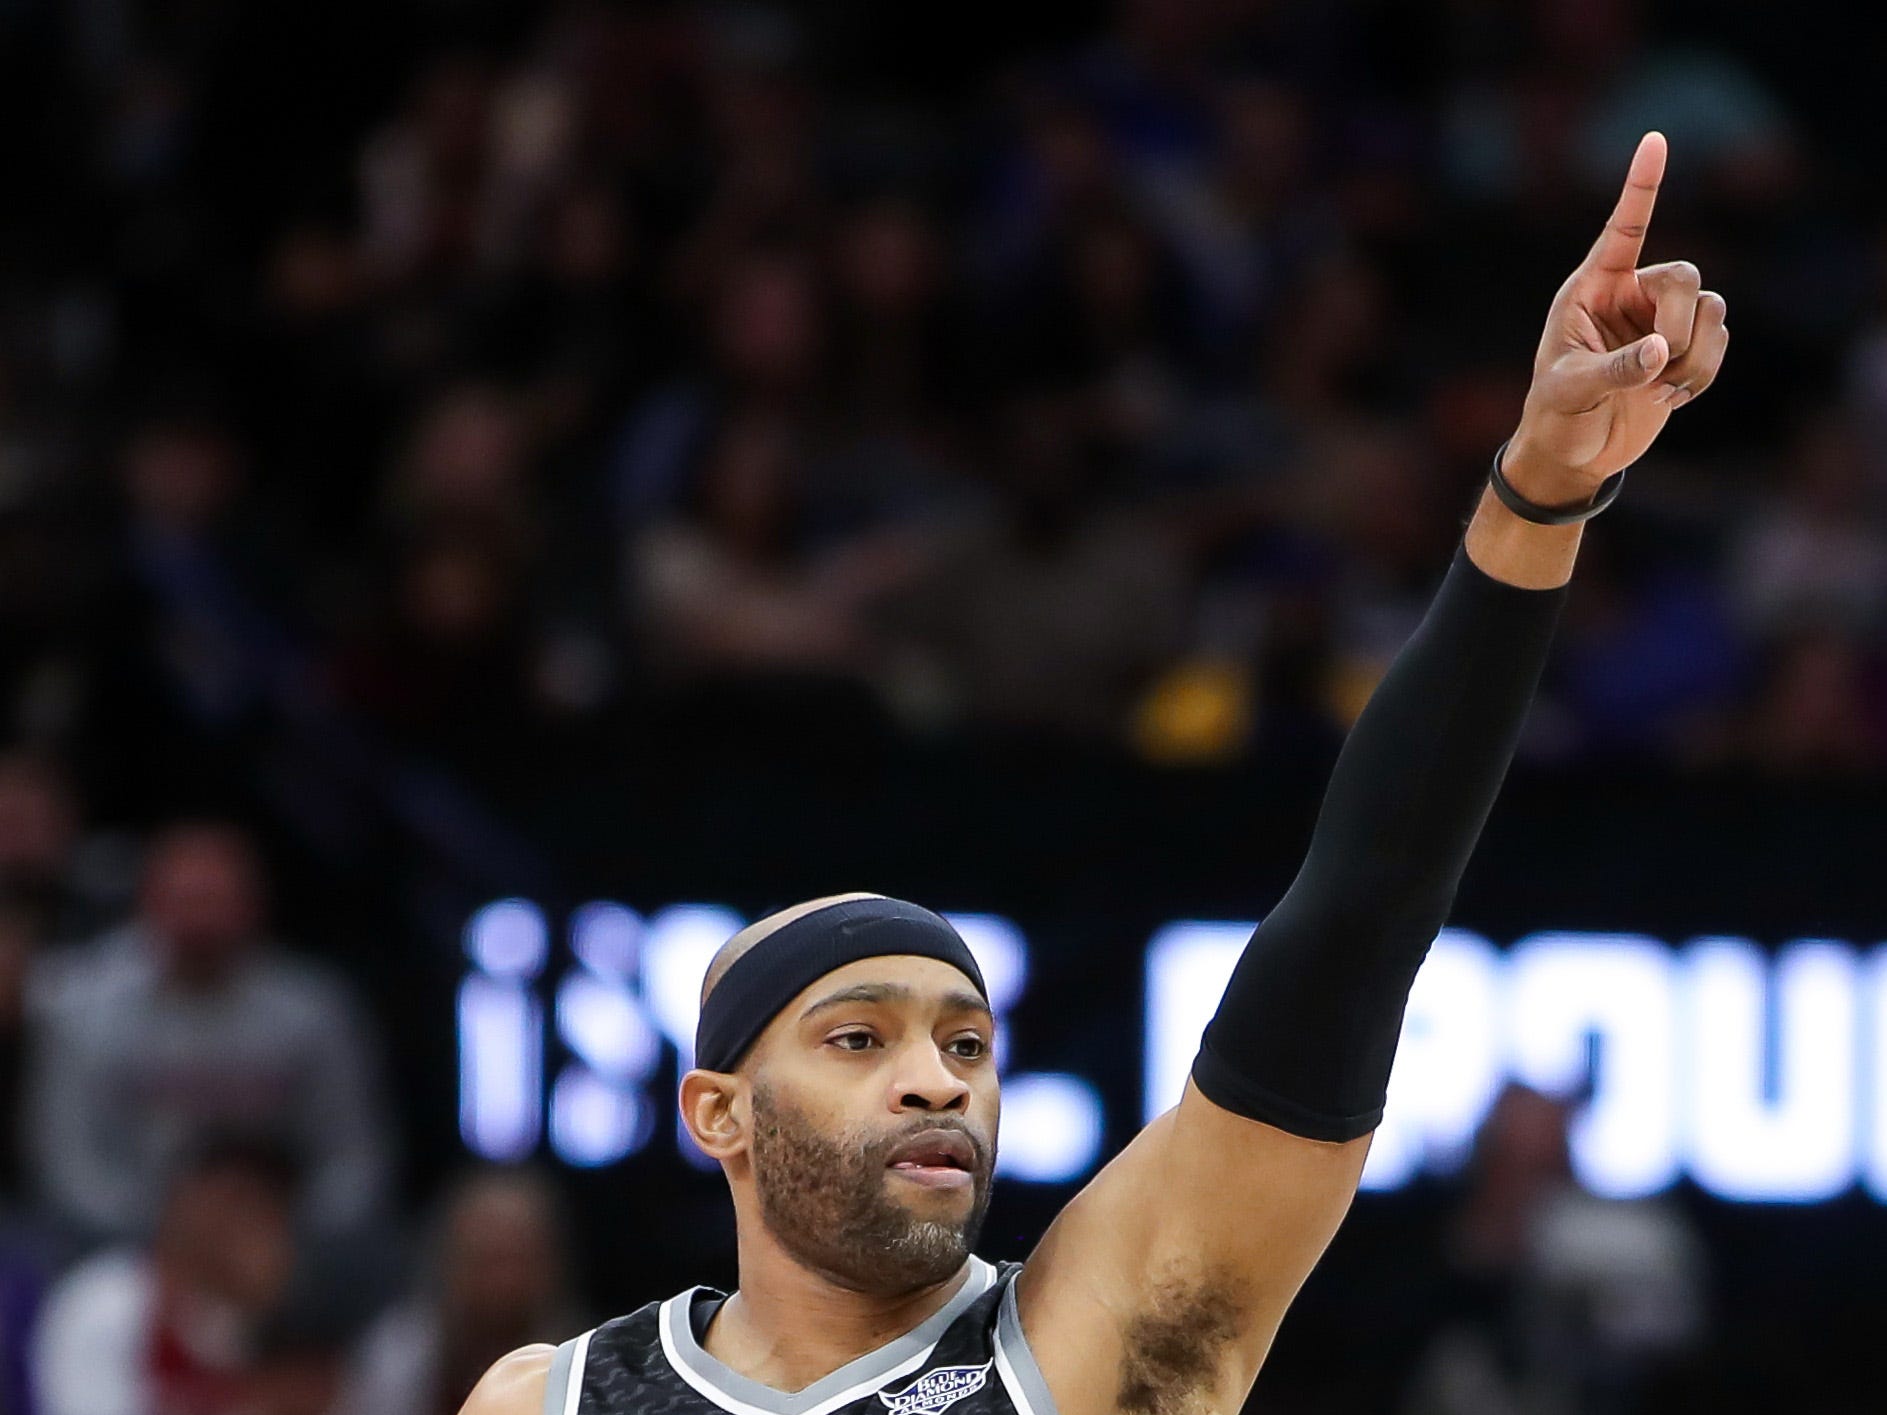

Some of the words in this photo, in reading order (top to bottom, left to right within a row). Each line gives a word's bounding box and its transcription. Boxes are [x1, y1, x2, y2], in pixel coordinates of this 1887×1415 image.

[894, 1369, 984, 1410] DIAMOND
[916, 1370, 959, 1393] BLUE
[899, 1384, 979, 1412] ALMONDS
